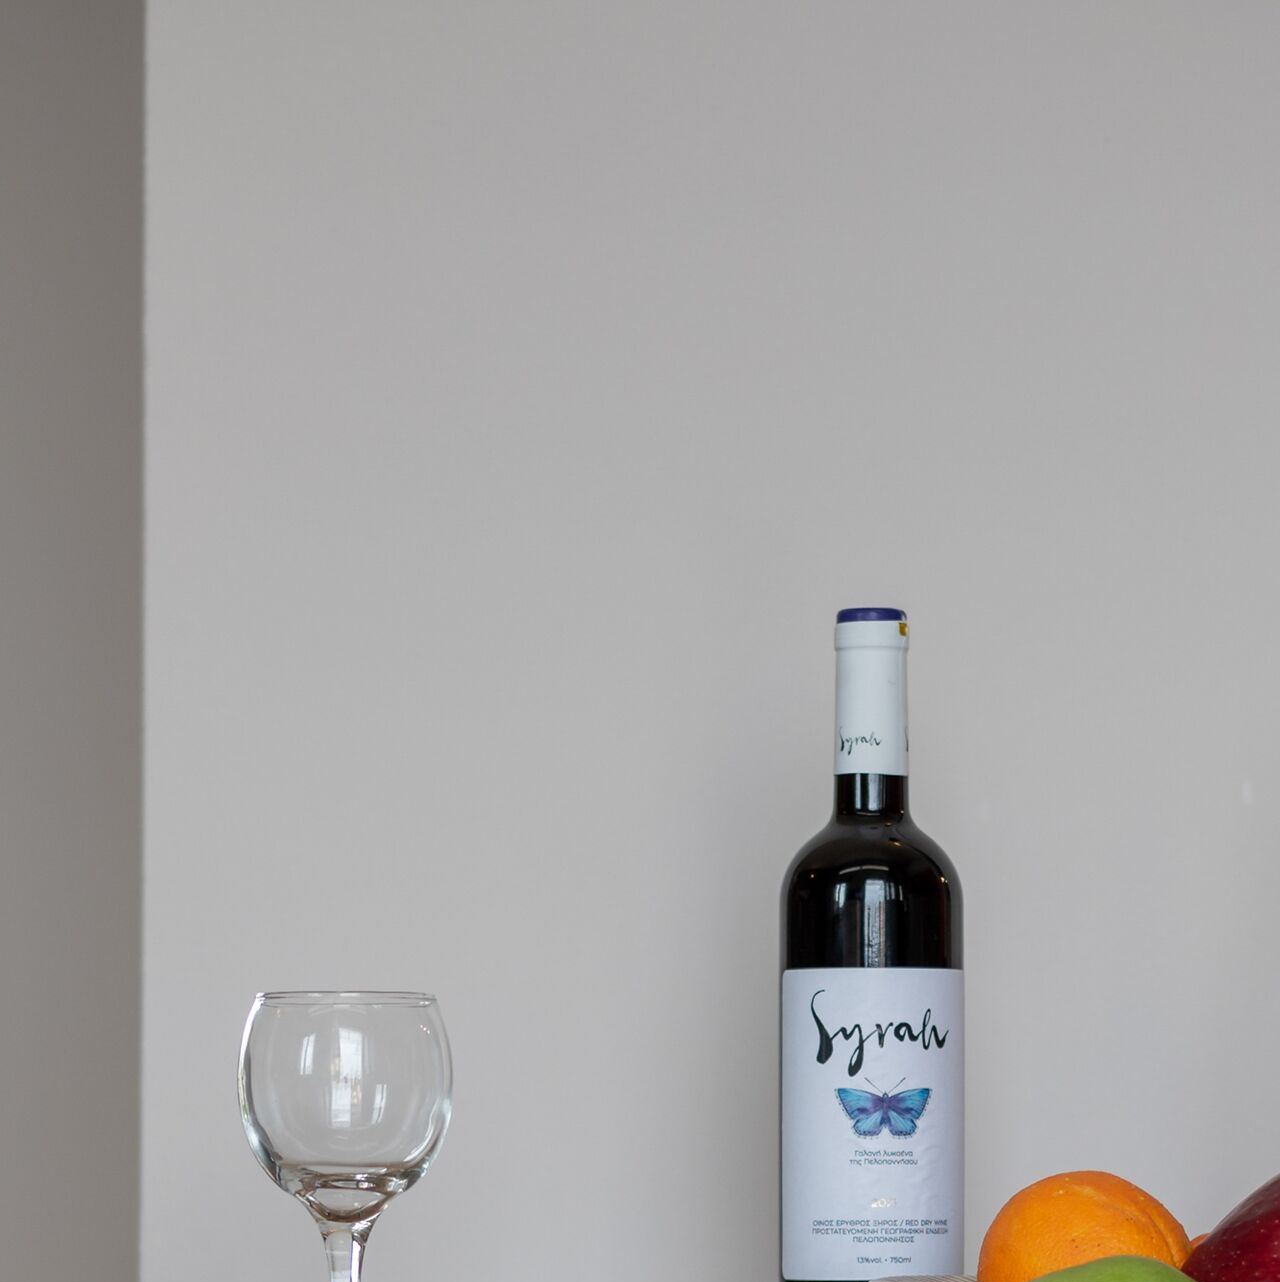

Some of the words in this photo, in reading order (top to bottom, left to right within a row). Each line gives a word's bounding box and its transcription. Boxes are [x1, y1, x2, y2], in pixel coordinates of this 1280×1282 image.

[839, 726, 882, 756] Syrah
[811, 989, 949, 1077] Syrah
[812, 1219, 834, 1227] ΟΙΝΟΣ
[836, 1219, 871, 1227] ΕΡΥΘΡΟΣ
[873, 1219, 898, 1227] ΞΗΡΟΣ
[905, 1219, 920, 1227] RED
[920, 1219, 933, 1227] DRY
[934, 1219, 948, 1227] WINE
